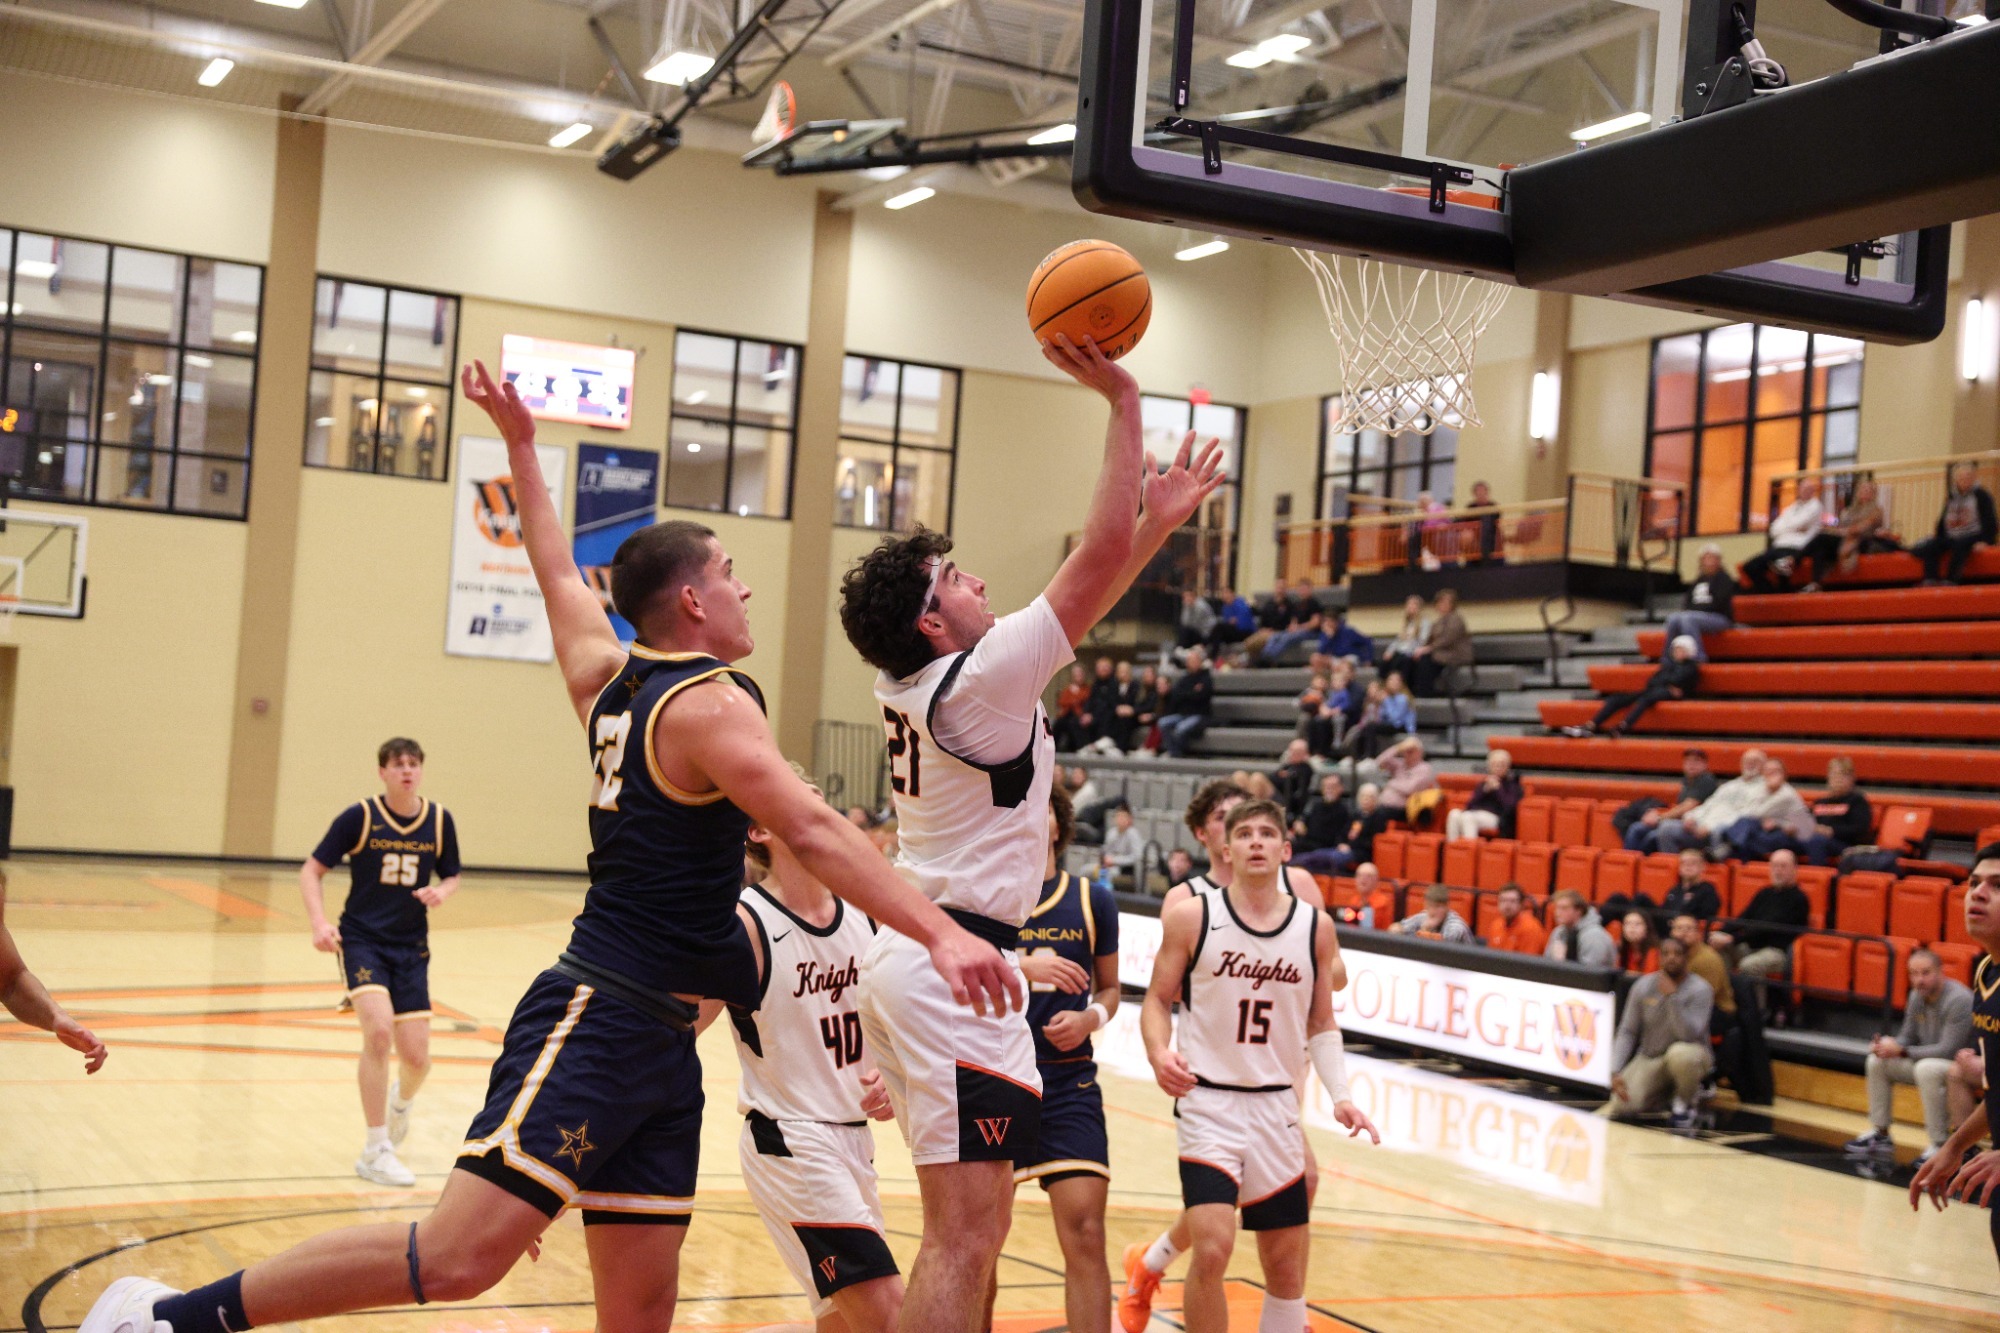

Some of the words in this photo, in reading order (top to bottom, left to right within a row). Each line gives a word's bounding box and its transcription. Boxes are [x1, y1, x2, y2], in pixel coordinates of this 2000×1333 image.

[883, 704, 921, 797] 21
[369, 838, 435, 852] DOMINICAN
[379, 853, 420, 886] 25
[793, 954, 861, 1004] Knigh
[1212, 949, 1303, 991] Knights
[1236, 998, 1275, 1045] 15
[1333, 968, 1545, 1056] OLLEGE
[819, 1010, 864, 1071] 40
[973, 1116, 1013, 1147] W
[818, 1255, 838, 1283] W
